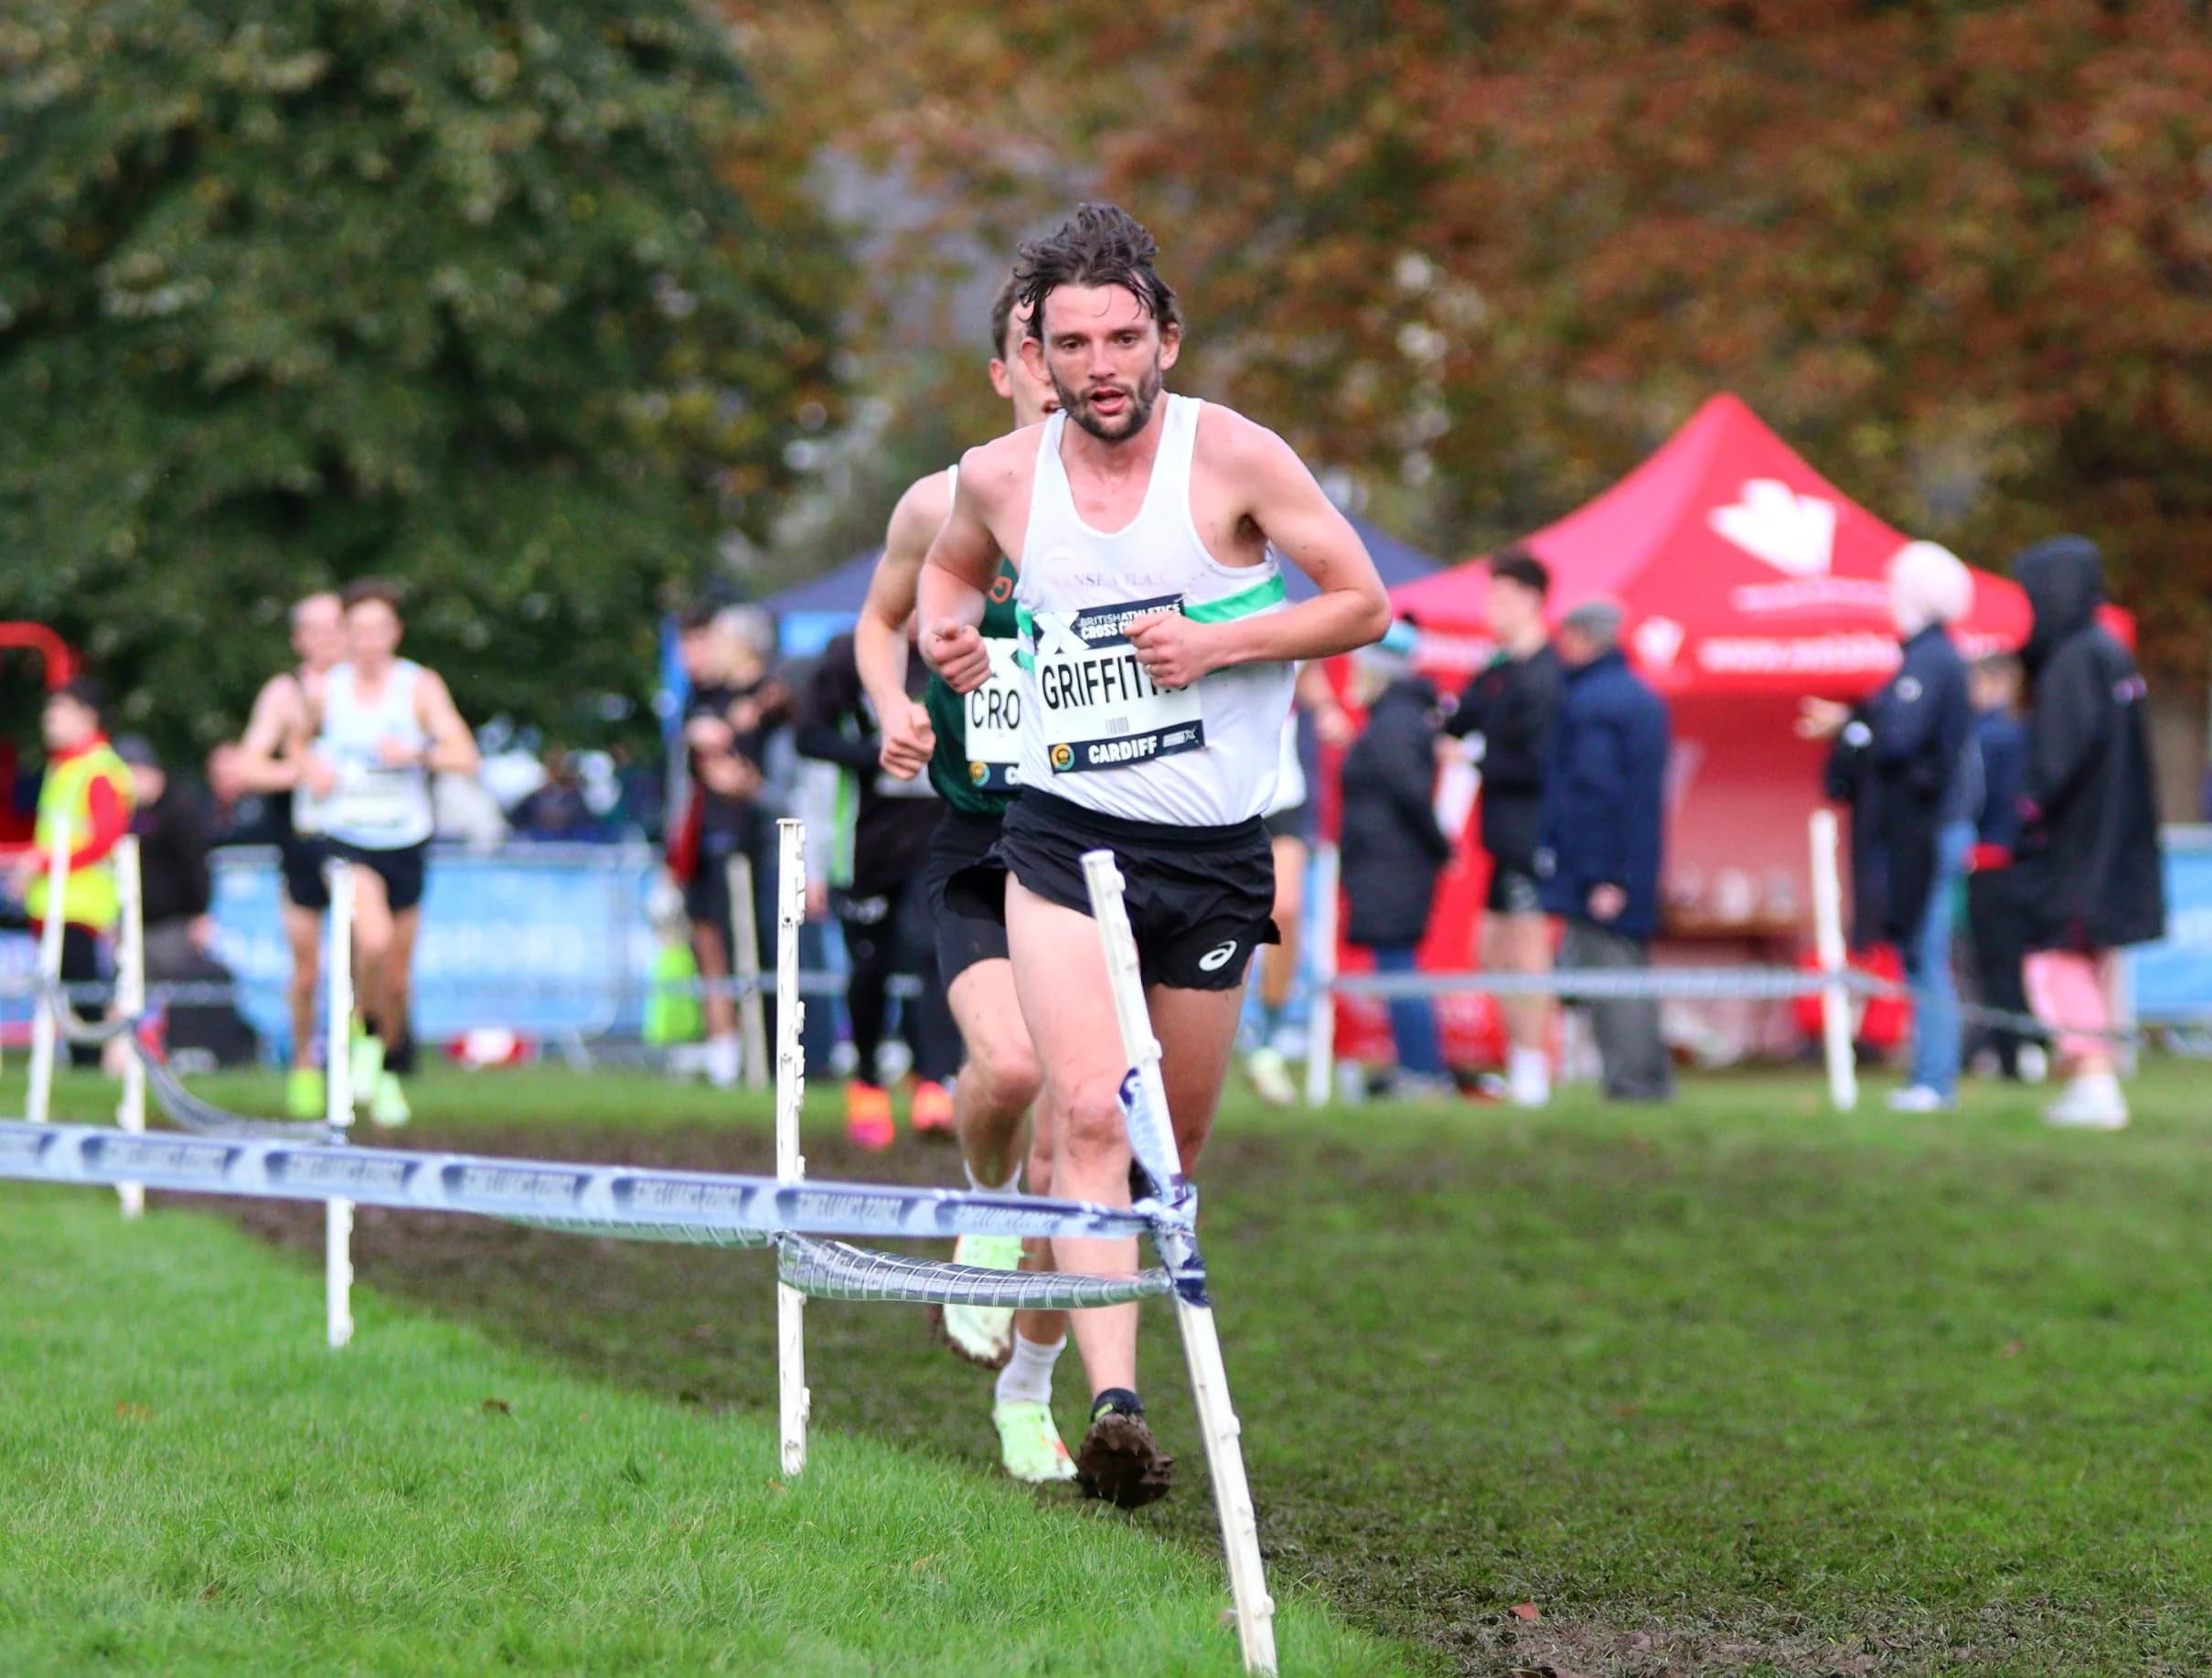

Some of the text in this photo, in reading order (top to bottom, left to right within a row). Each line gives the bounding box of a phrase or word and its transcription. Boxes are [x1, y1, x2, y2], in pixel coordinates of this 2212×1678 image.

[1081, 622, 1118, 640] CROSS
[1042, 654, 1189, 711] GRIFFIT
[1087, 735, 1158, 764] CARDIFF
